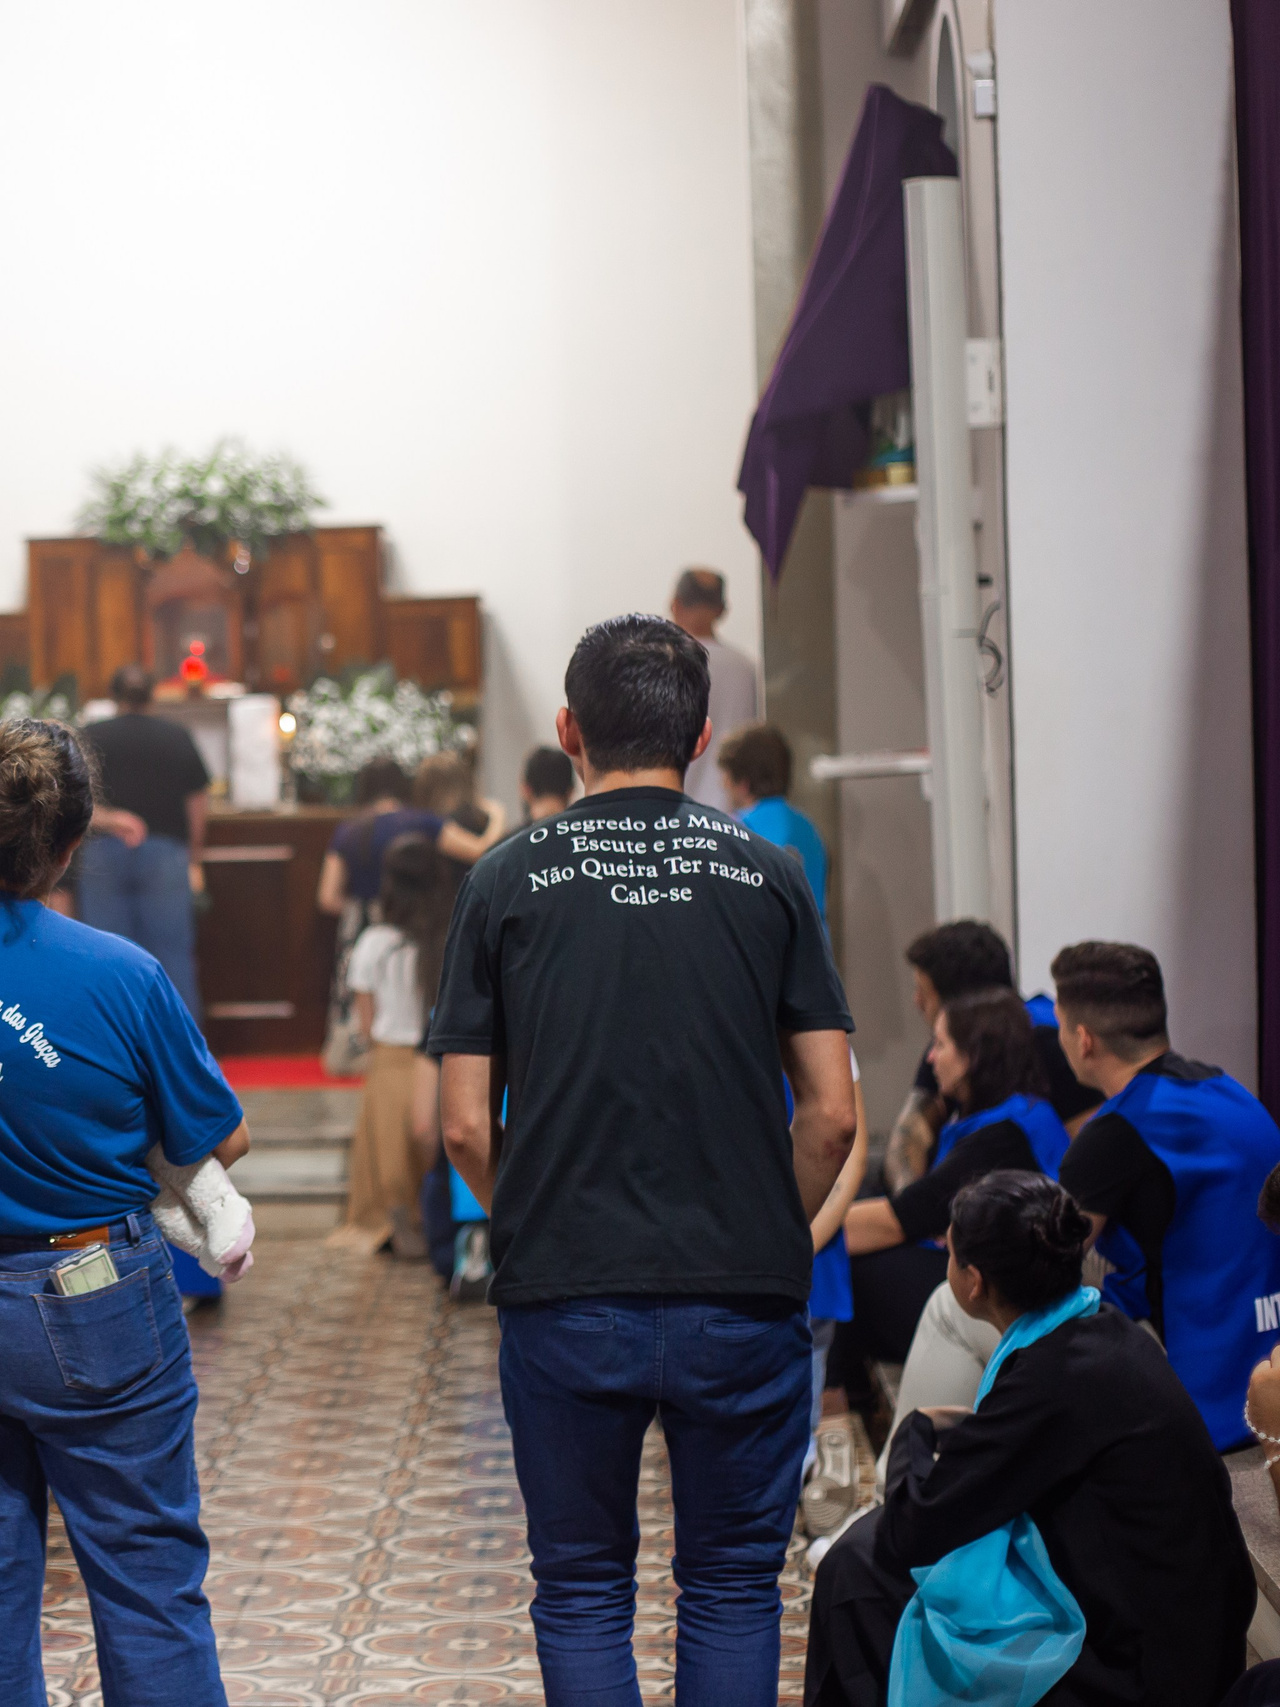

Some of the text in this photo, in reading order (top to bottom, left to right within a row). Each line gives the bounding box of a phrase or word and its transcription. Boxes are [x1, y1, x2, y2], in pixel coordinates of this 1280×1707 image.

[529, 814, 751, 844] O Segredo de Maria
[571, 835, 718, 854] Escute e reze
[528, 855, 764, 893] Não Queira Ter razão
[610, 883, 693, 906] Cale-se
[1, 1003, 26, 1032] das
[19, 1022, 62, 1069] Graças
